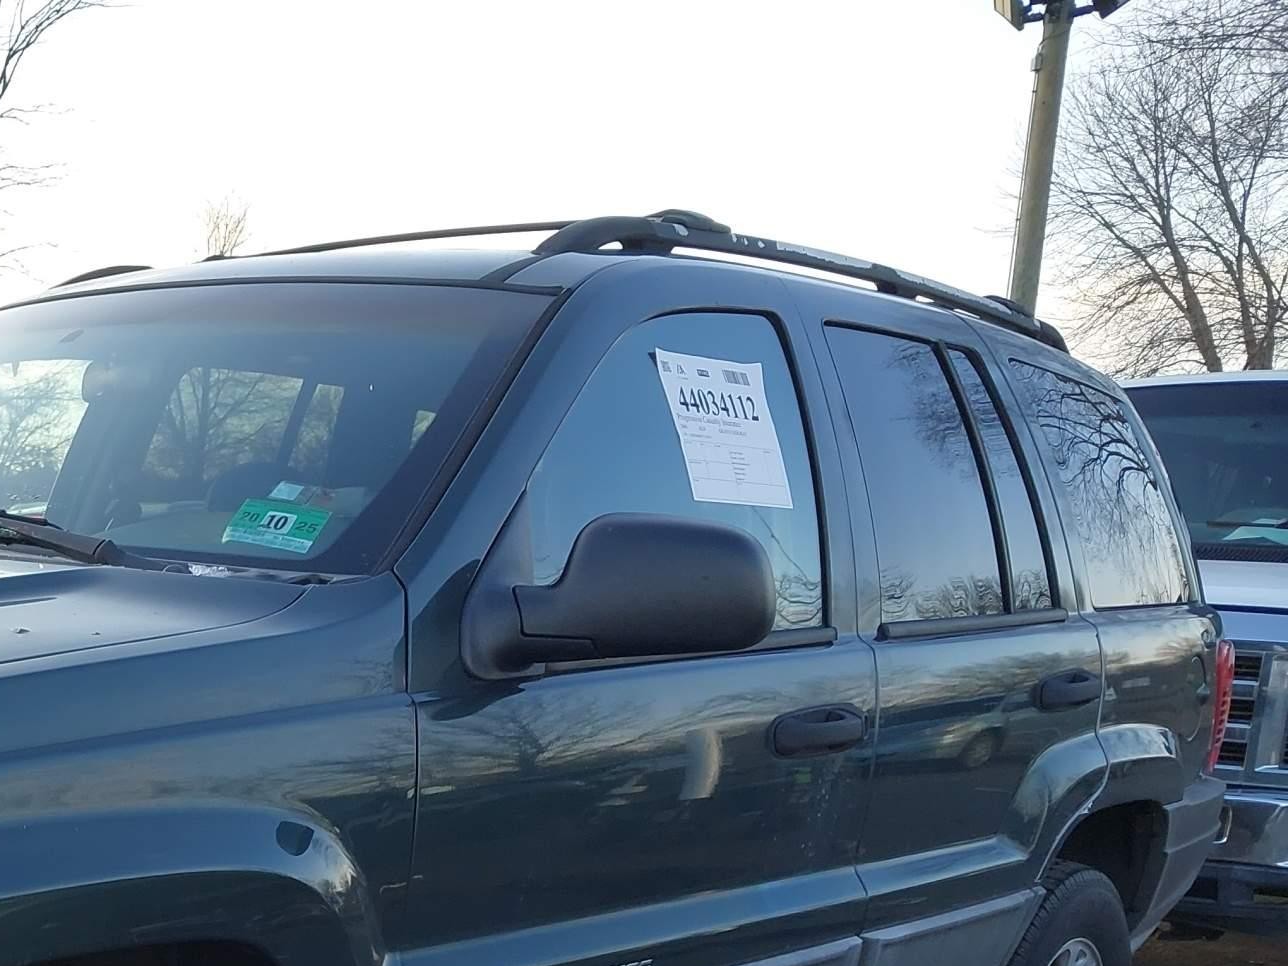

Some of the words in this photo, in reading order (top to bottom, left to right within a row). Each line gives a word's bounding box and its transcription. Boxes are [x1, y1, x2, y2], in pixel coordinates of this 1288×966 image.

[678, 386, 760, 421] 44034112
[266, 514, 289, 530] 10
[295, 521, 319, 533] 25
